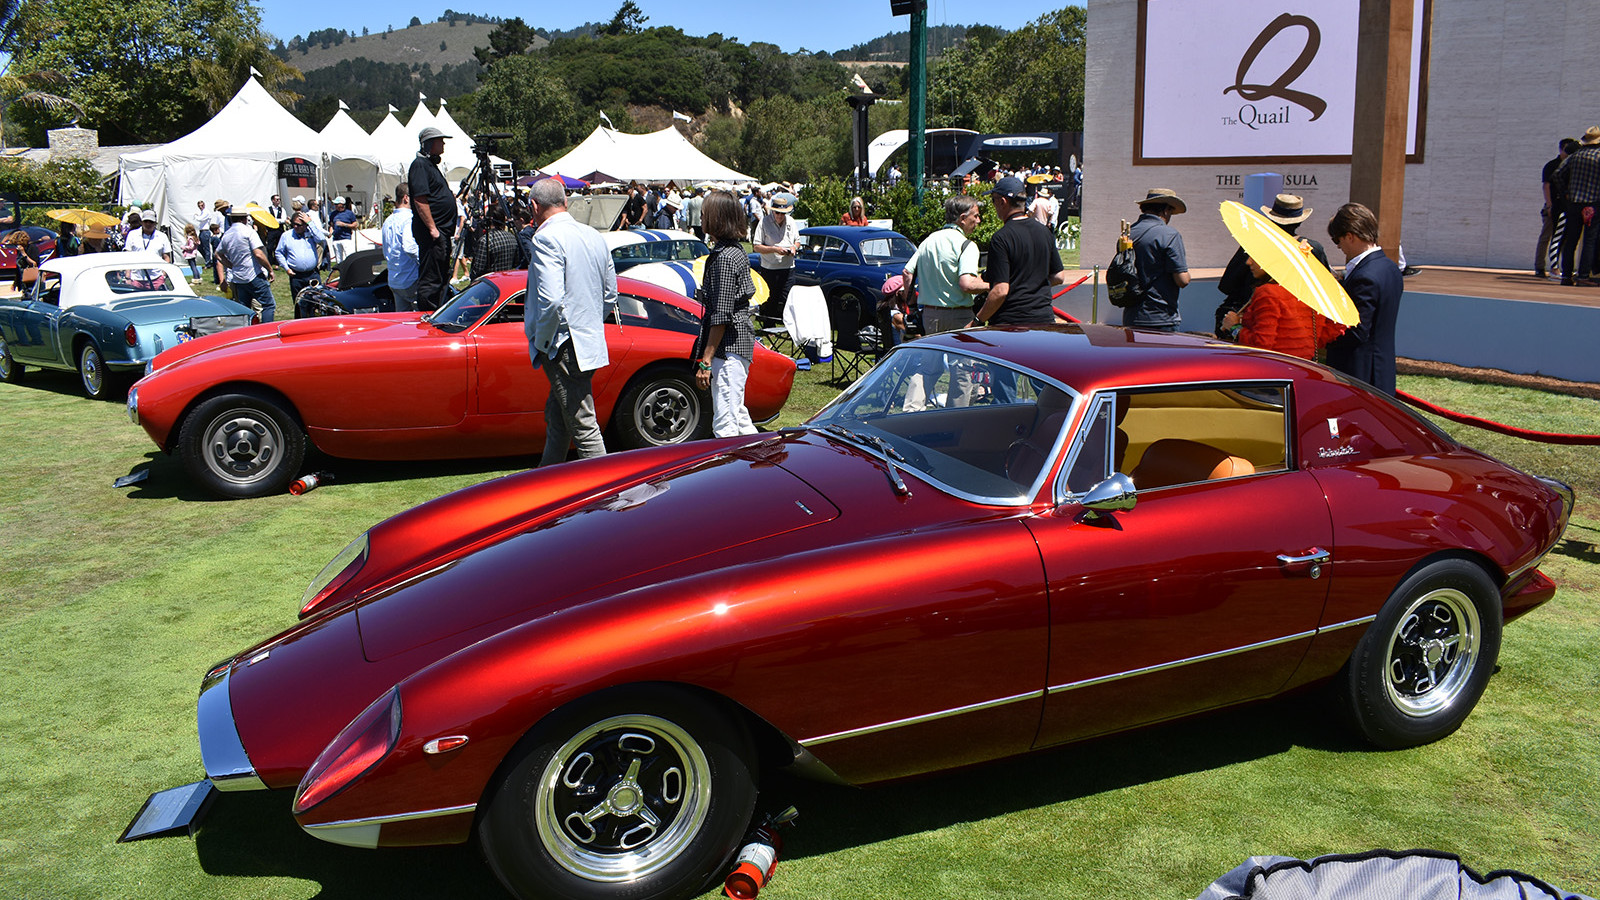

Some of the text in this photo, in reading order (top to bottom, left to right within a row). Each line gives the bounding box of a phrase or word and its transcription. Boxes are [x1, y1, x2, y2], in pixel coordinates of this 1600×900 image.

[1223, 12, 1327, 122] Q
[1221, 104, 1290, 131] The Quail
[1216, 174, 1241, 186] THE
